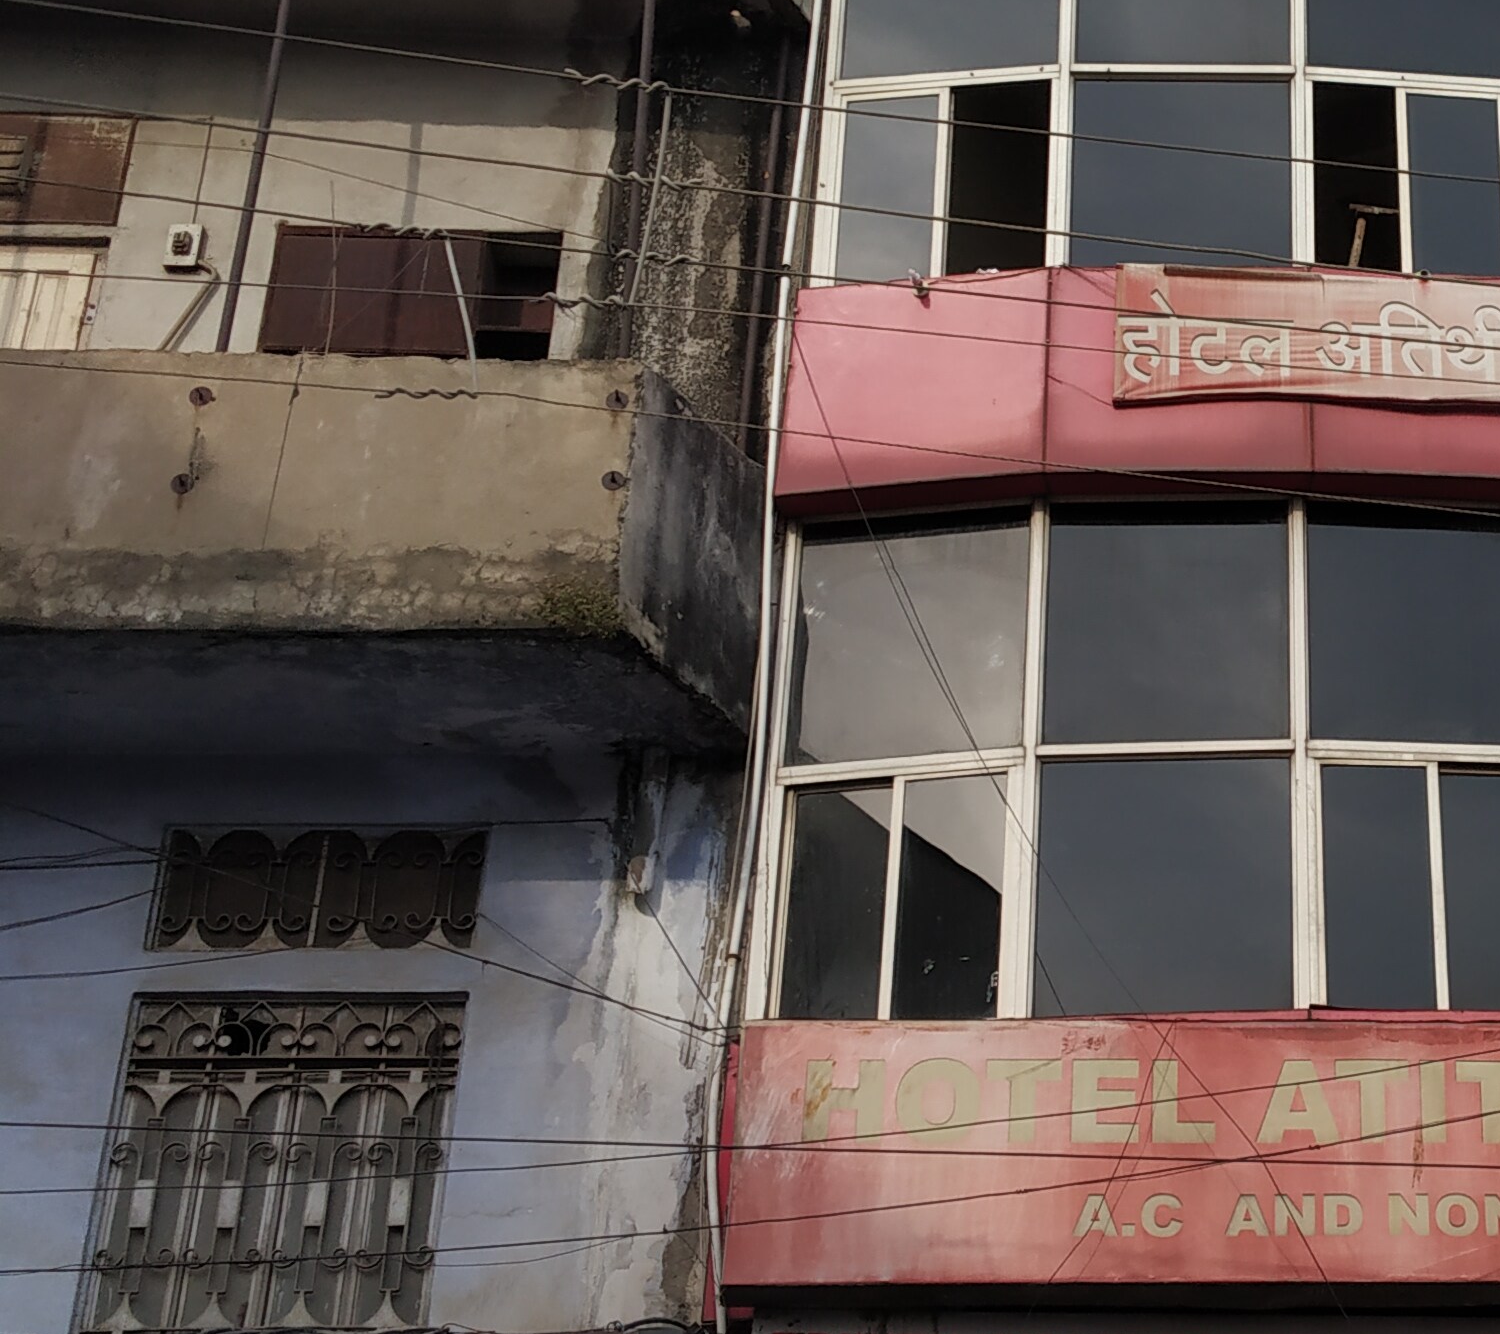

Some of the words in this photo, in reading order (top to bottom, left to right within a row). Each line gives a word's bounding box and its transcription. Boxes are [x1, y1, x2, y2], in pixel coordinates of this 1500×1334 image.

[1118, 288, 1295, 384] होटल
[802, 1058, 1217, 1144] HOTEL
[1072, 1192, 1185, 1239] A.C
[1225, 1193, 1364, 1238] AND
